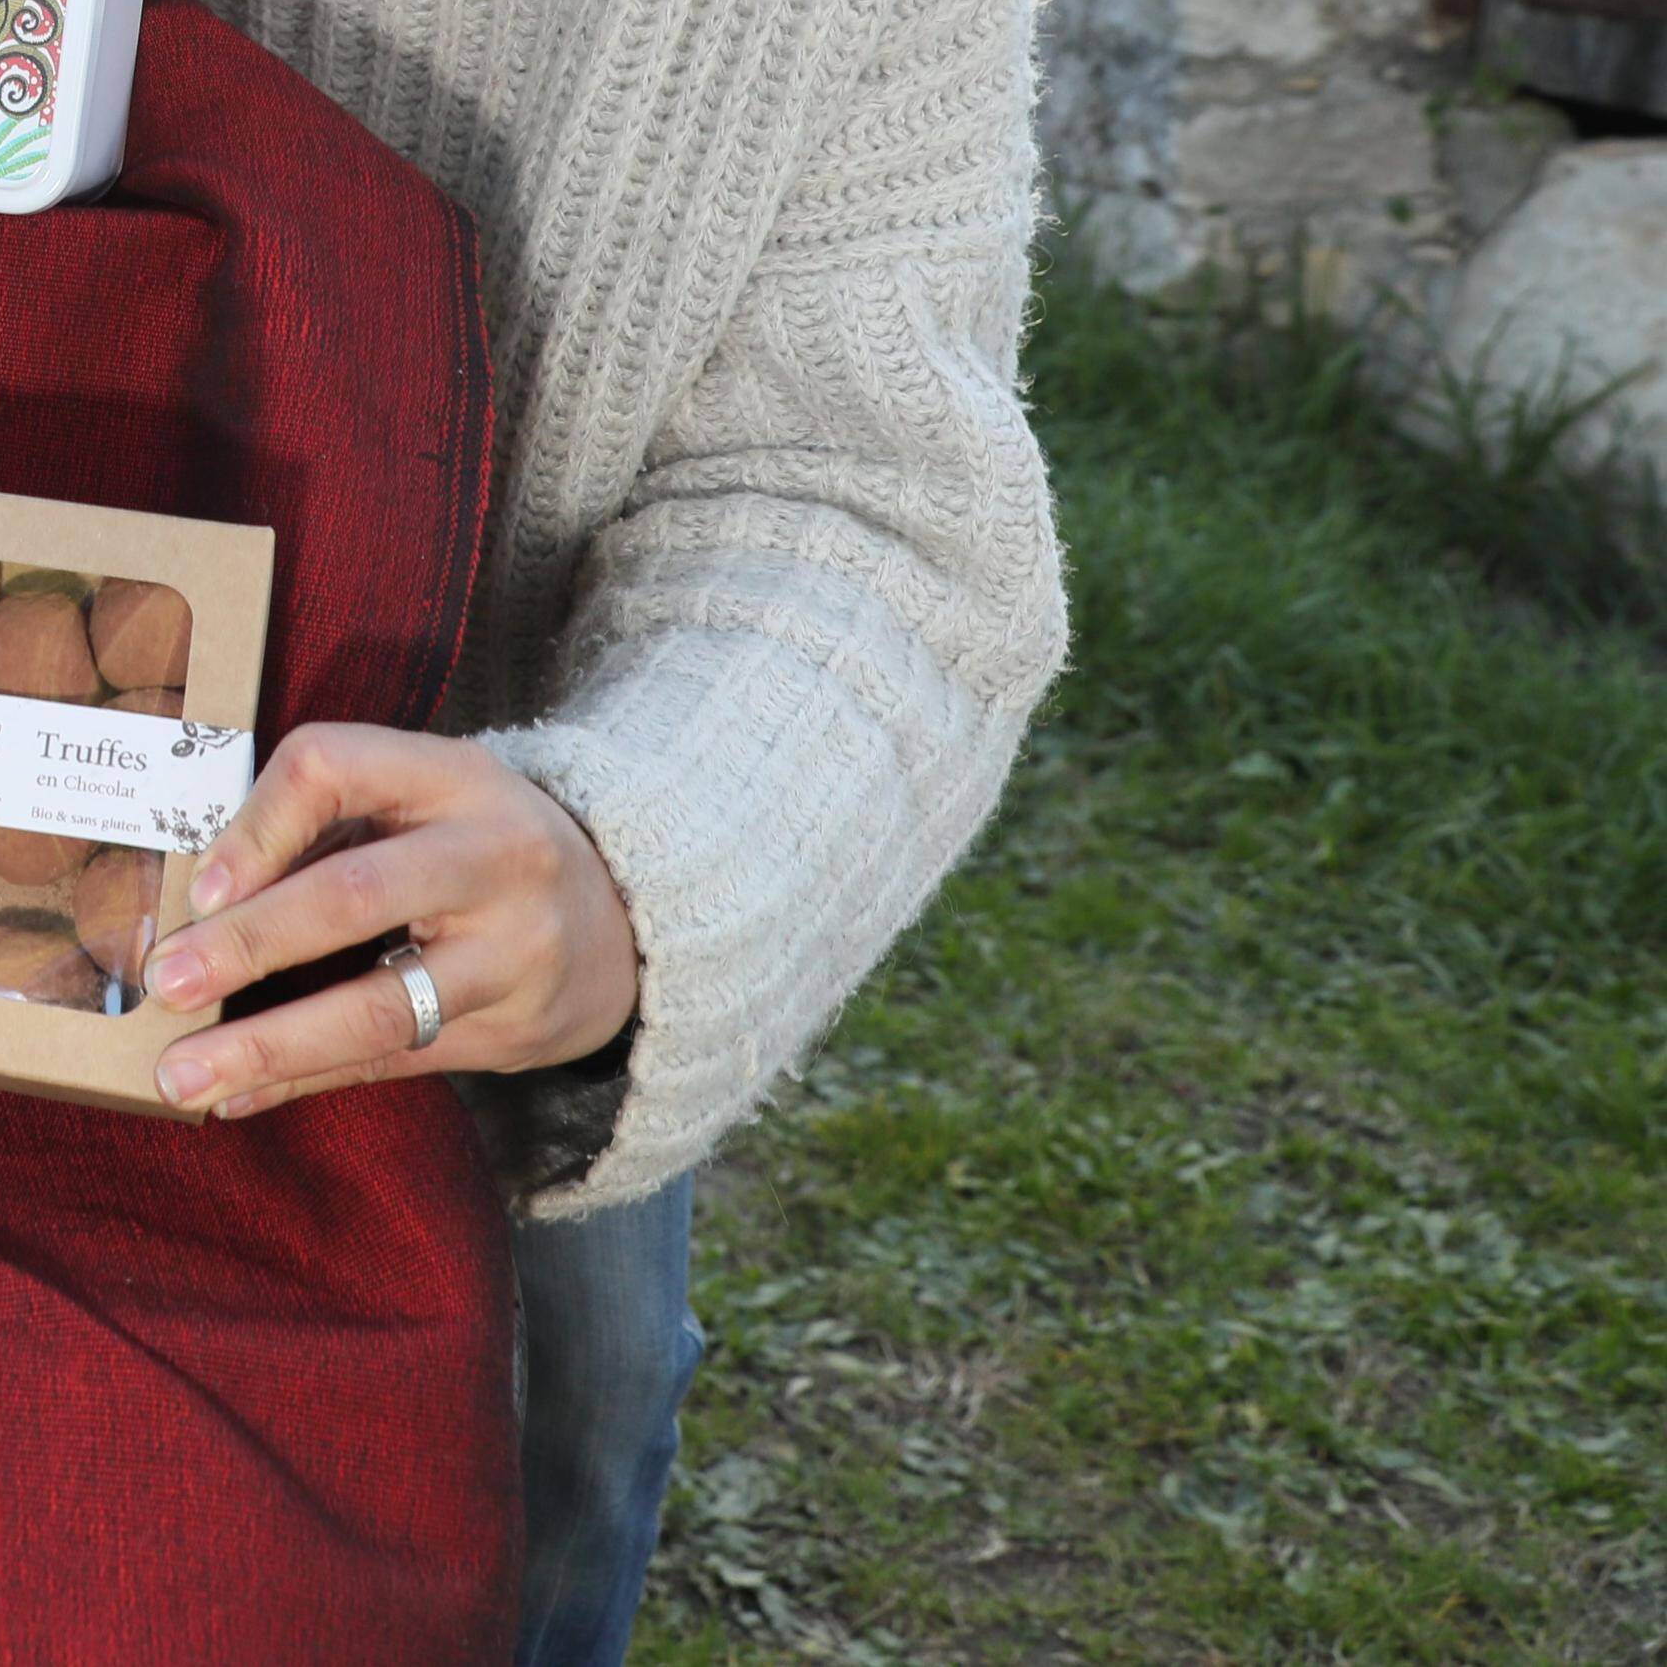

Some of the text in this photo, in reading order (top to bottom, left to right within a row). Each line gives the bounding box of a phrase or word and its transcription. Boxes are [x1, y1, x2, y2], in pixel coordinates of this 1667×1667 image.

[37, 730, 147, 772] Truffes
[36, 774, 136, 799] en Chocolat
[31, 806, 142, 833] Bio & sans gluten
